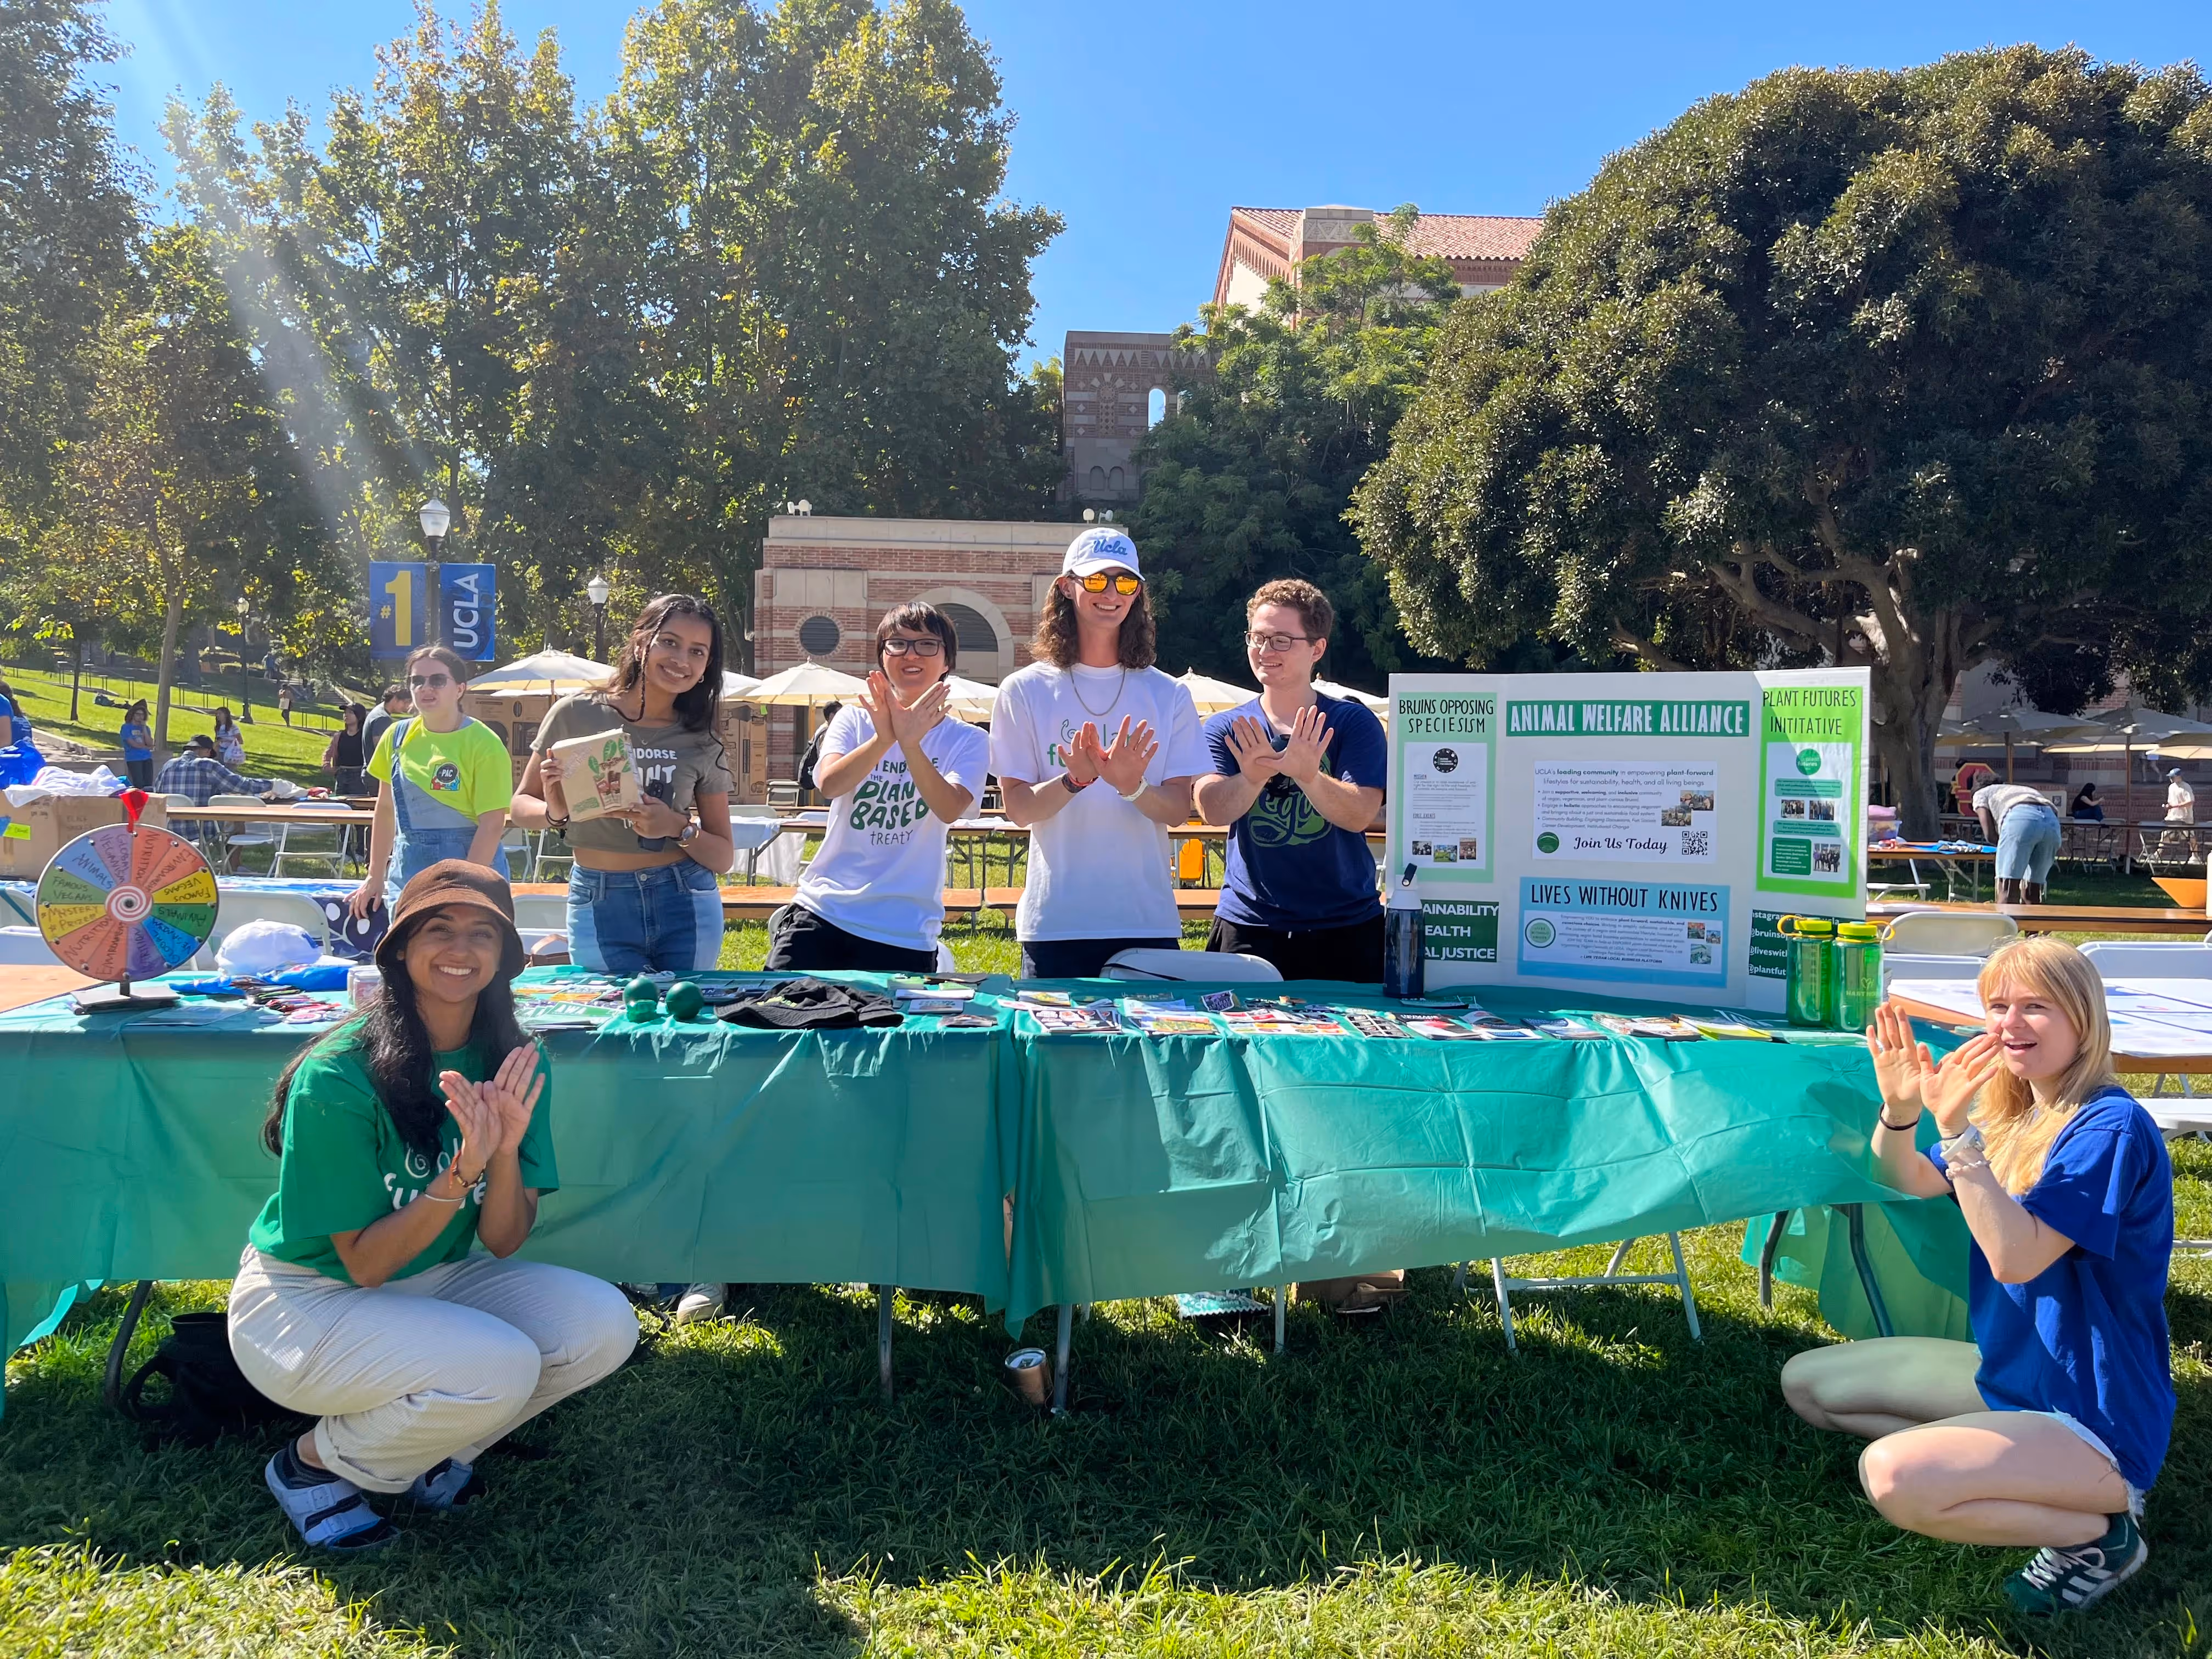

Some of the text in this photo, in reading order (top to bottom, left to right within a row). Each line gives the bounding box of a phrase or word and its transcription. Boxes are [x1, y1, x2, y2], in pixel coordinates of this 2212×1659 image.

[453, 573, 479, 648] UCLA
[1400, 699, 1493, 714] BRUINS OPPOSING
[1763, 690, 1856, 707] PLANT FUTURES
[1409, 717, 1485, 733] SPECIESISM
[1510, 704, 1743, 733] ANIMAL WELFARE ALLIANCE
[1770, 716, 1842, 735] INITITATIVE
[441, 769, 453, 777] PAC
[850, 798, 929, 830] BASED
[1573, 837, 1668, 854] Join Us Today
[72, 853, 112, 890] ANIMALS
[53, 876, 88, 892] FAMOUS
[164, 877, 202, 896] VEGANS
[54, 890, 93, 901] VEGANS
[173, 887, 212, 902] FAMOUS
[1532, 884, 1718, 912] LIVES WITHOUT KNIVES
[48, 905, 98, 922] MYSTERY
[159, 906, 207, 927] ANIMALS
[1422, 904, 1499, 916] AINABILITY
[64, 917, 113, 962] NUTRITION
[1425, 925, 1471, 937] EALTH
[1441, 947, 1495, 960] JUSTICE
[555, 1004, 587, 1014] AWA
